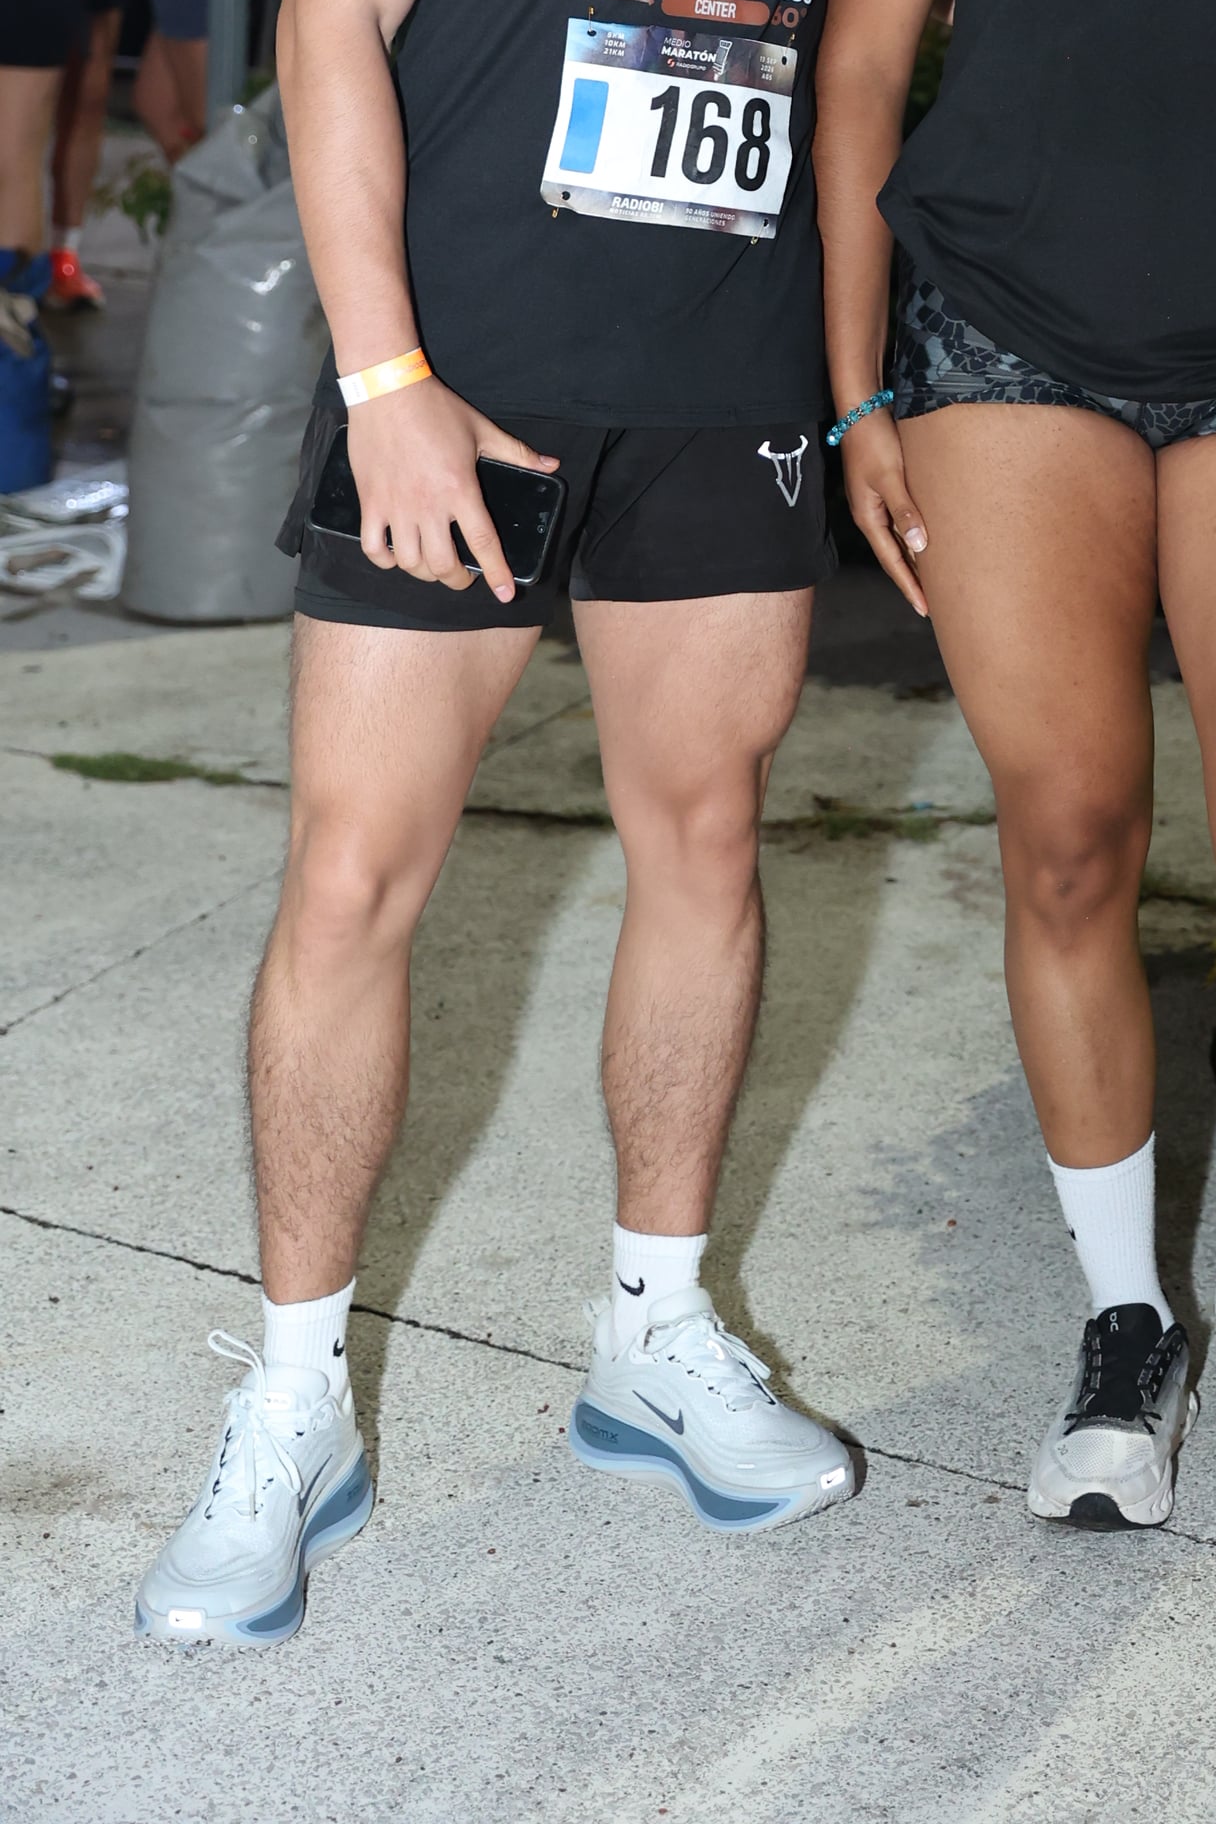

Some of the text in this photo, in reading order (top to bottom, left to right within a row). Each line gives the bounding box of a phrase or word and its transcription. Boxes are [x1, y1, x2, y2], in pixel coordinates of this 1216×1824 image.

[604, 39, 626, 49] 10KM
[663, 37, 692, 48] MEDIO
[603, 47, 625, 56] 21KM
[661, 45, 717, 63] MARATÓN
[649, 85, 772, 192] 168
[611, 196, 664, 214] RADIOBI
